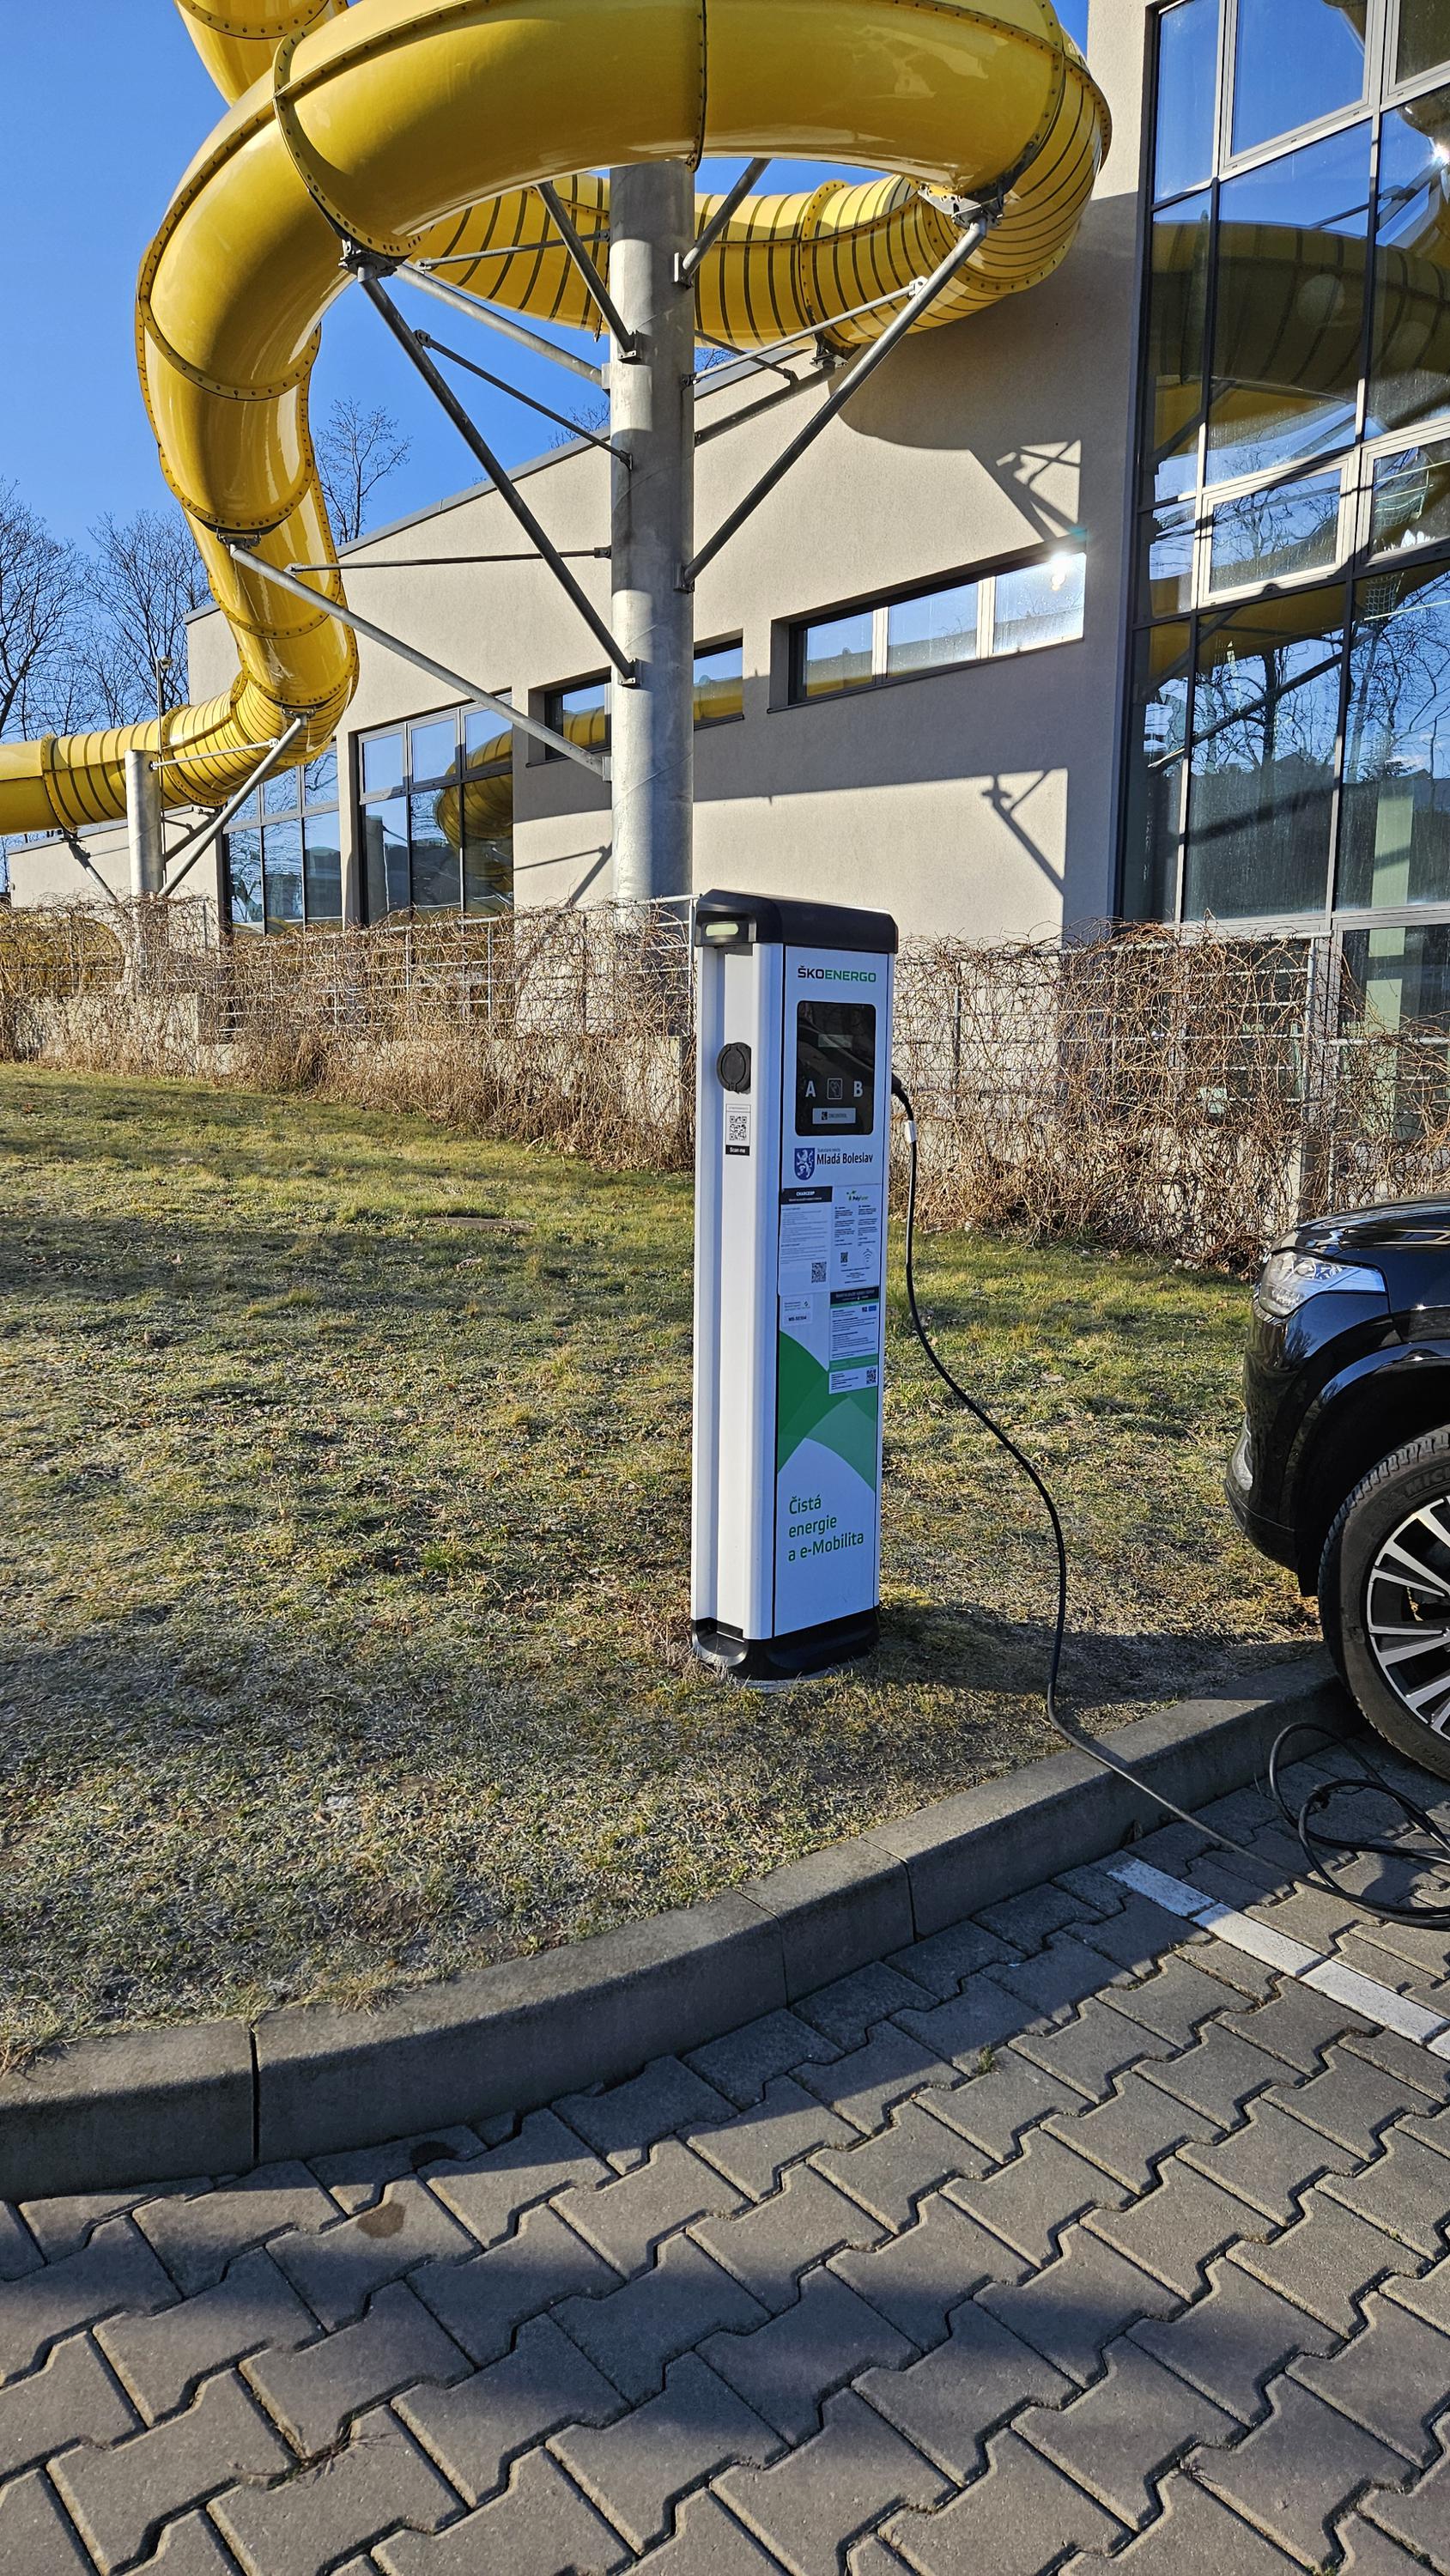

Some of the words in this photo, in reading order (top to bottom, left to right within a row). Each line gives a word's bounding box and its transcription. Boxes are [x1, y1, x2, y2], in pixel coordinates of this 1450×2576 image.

[798, 965, 877, 982] ŠKOENERGO
[805, 1080, 816, 1097] A
[853, 1080, 864, 1097] B
[816, 1152, 840, 1165] Mladá
[842, 1151, 873, 1164] Boleslav
[789, 1494, 822, 1515] Čistá
[788, 1515, 837, 1538] energie
[788, 1550, 796, 1562] a
[800, 1532, 864, 1558] e-Mobilita
